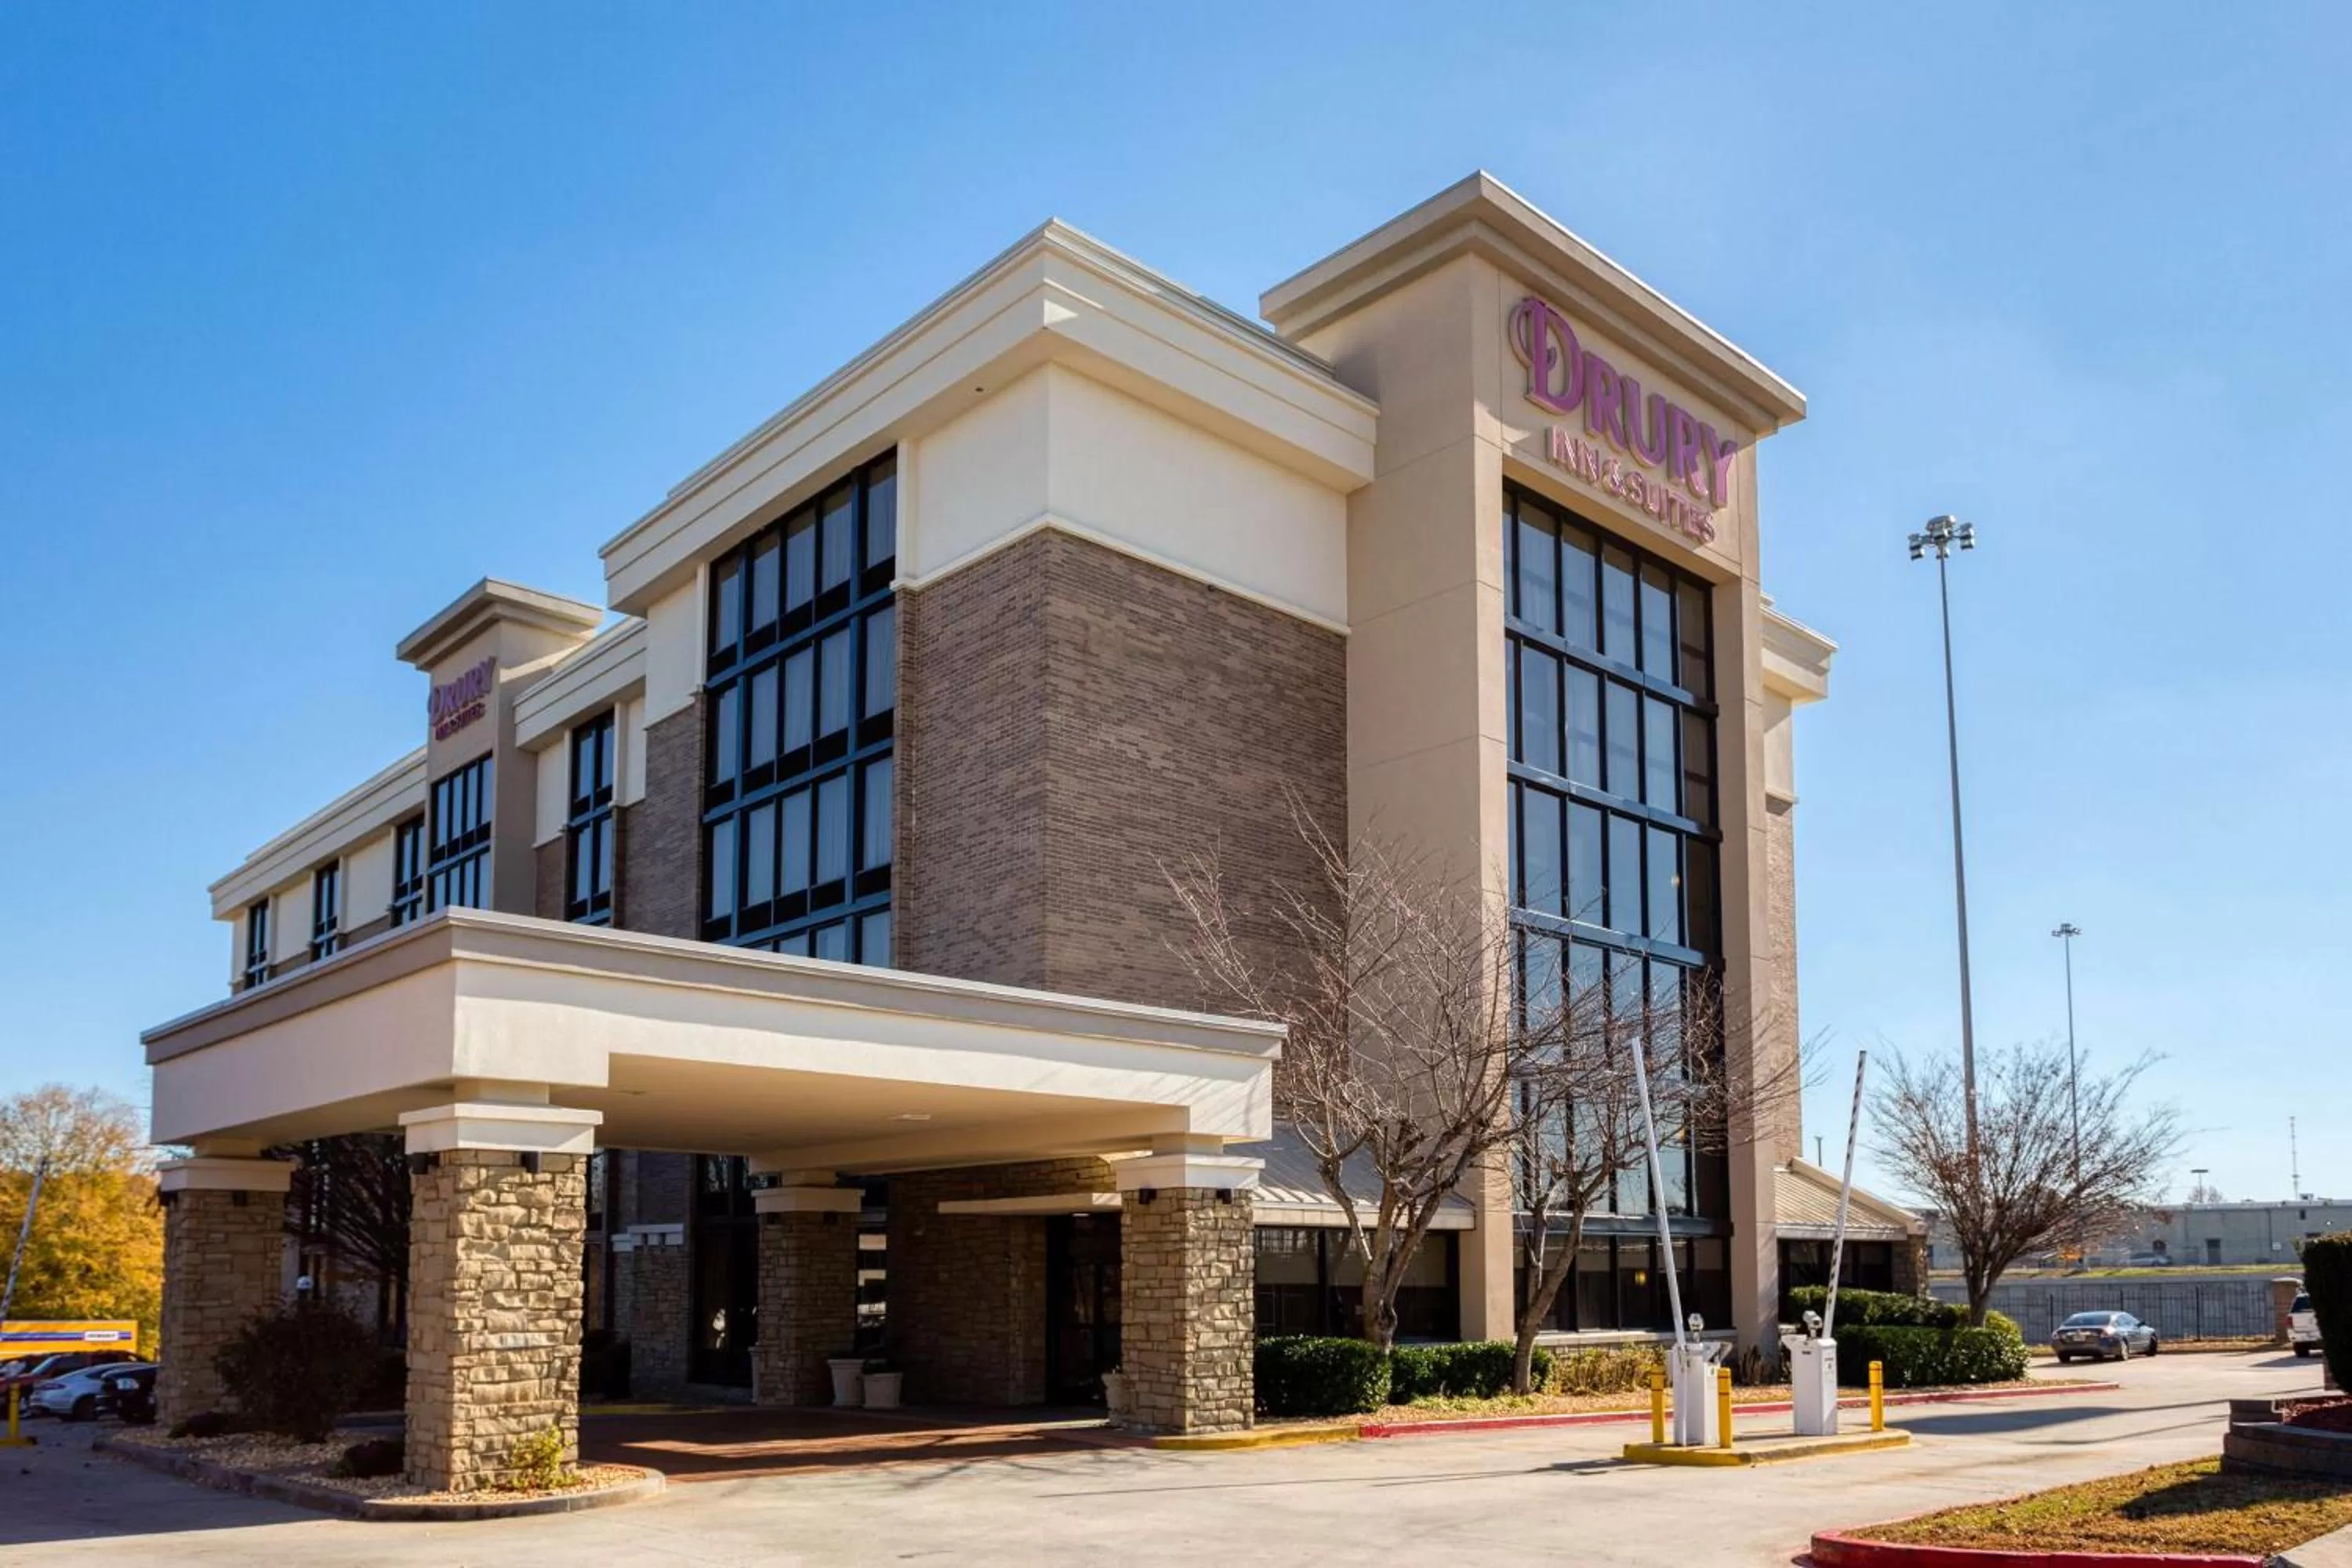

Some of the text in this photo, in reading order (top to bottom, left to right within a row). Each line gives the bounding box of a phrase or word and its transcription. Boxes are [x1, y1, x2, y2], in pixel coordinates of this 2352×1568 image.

[1508, 296, 1738, 510] DRURY
[1545, 424, 1600, 485] INN
[1623, 470, 1715, 544] SUITES
